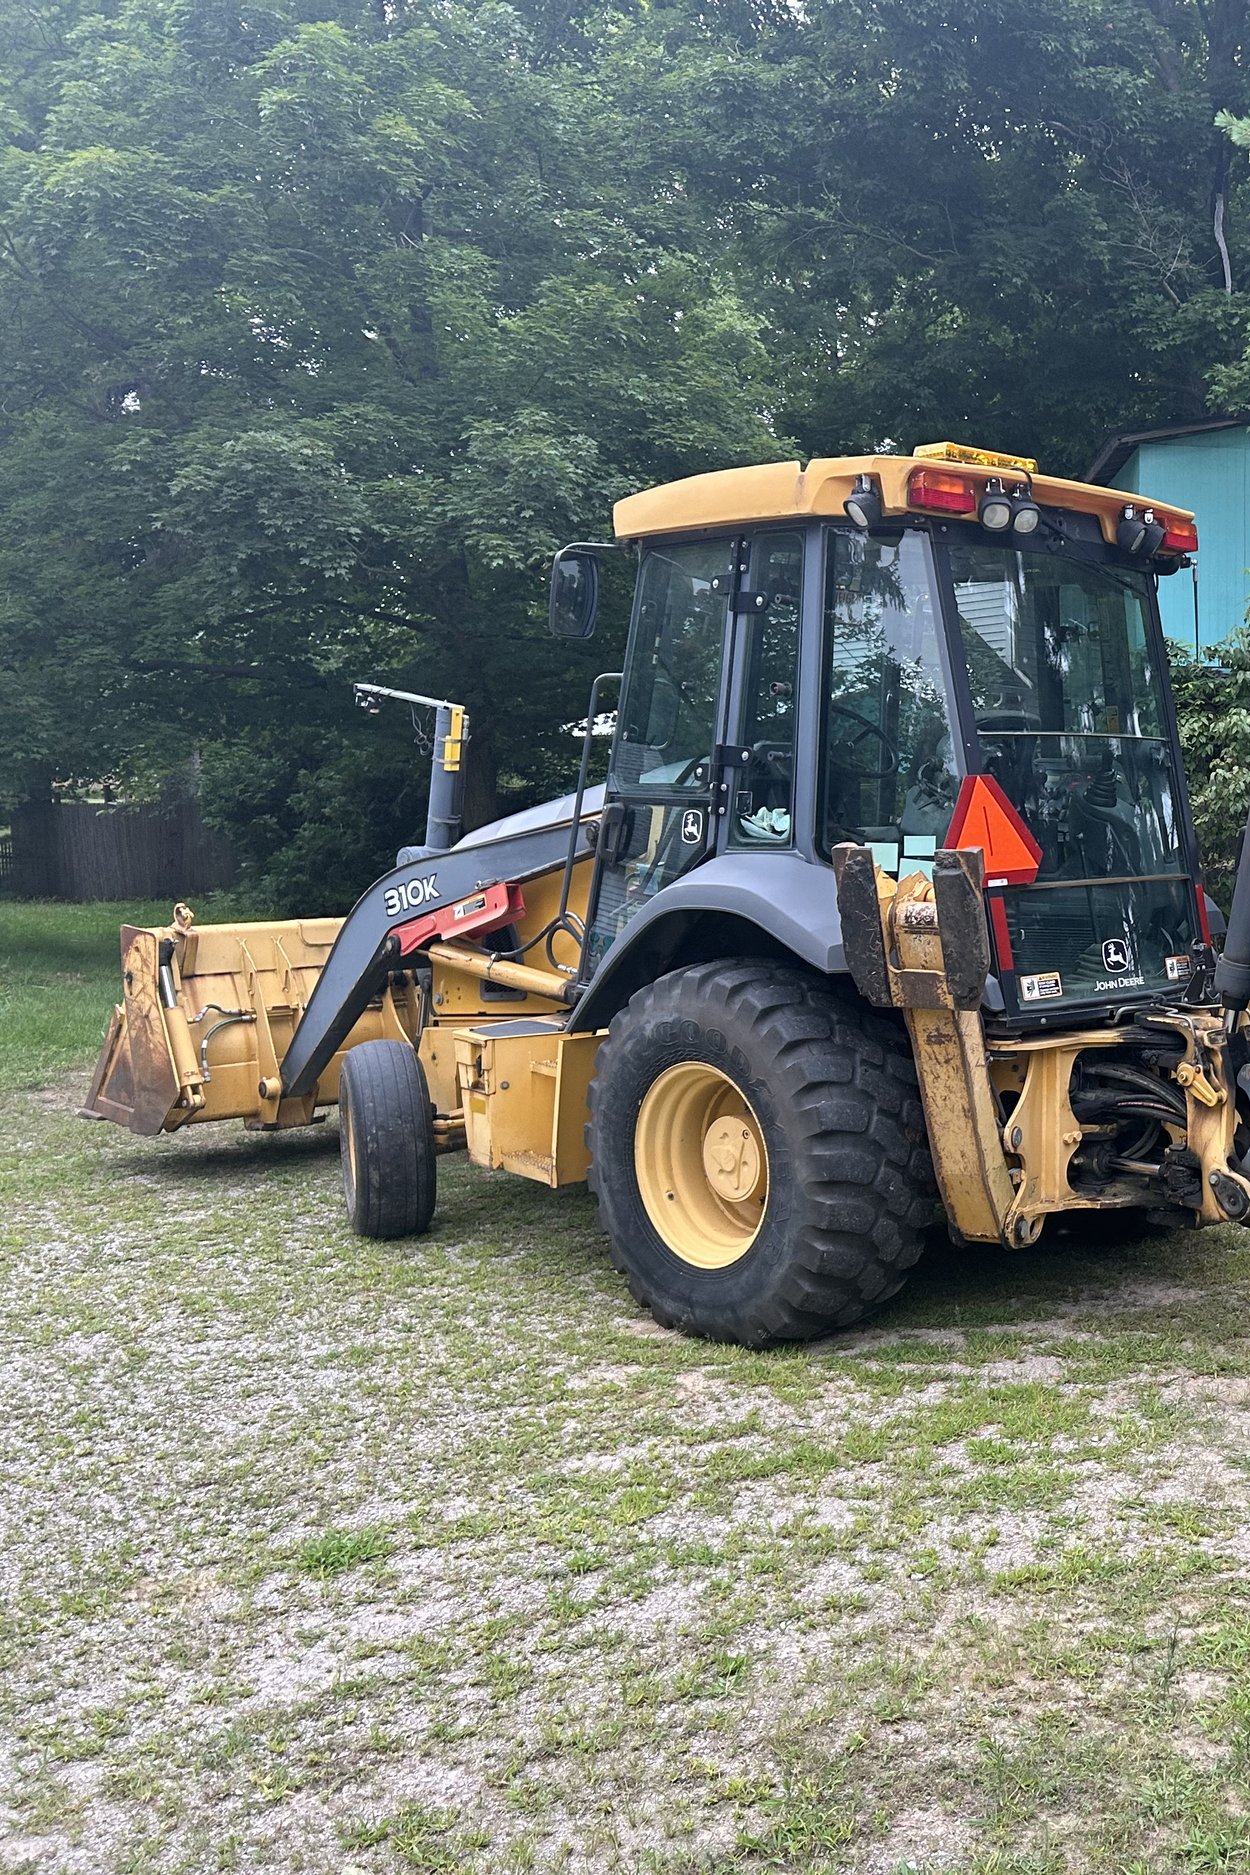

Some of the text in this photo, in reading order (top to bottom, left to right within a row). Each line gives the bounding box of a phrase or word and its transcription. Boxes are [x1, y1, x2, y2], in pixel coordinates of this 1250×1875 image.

[384, 873, 442, 917] 310K
[1094, 976, 1145, 991] JOHN DEERE
